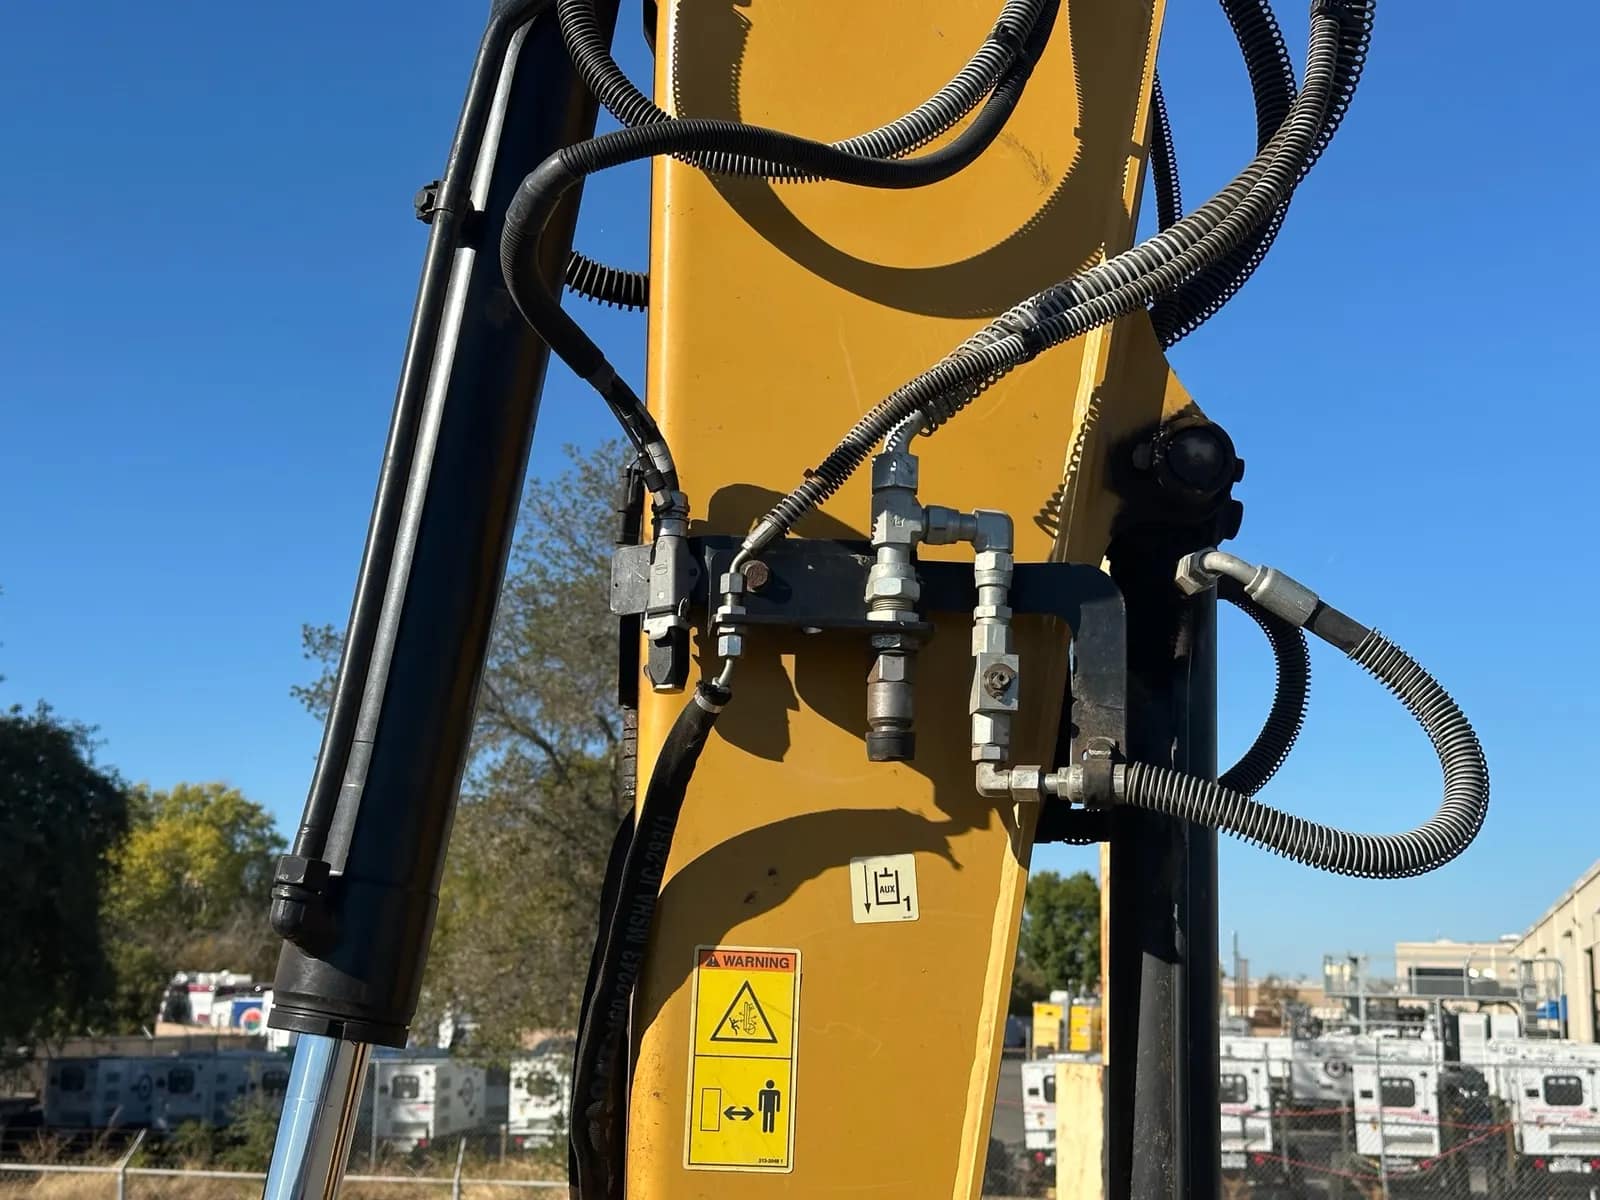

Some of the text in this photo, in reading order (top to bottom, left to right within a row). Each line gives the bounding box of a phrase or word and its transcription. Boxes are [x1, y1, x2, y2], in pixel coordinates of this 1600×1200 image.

[879, 885, 895, 894] AUX
[903, 895, 911, 912] 1
[723, 954, 790, 969] WARNING
